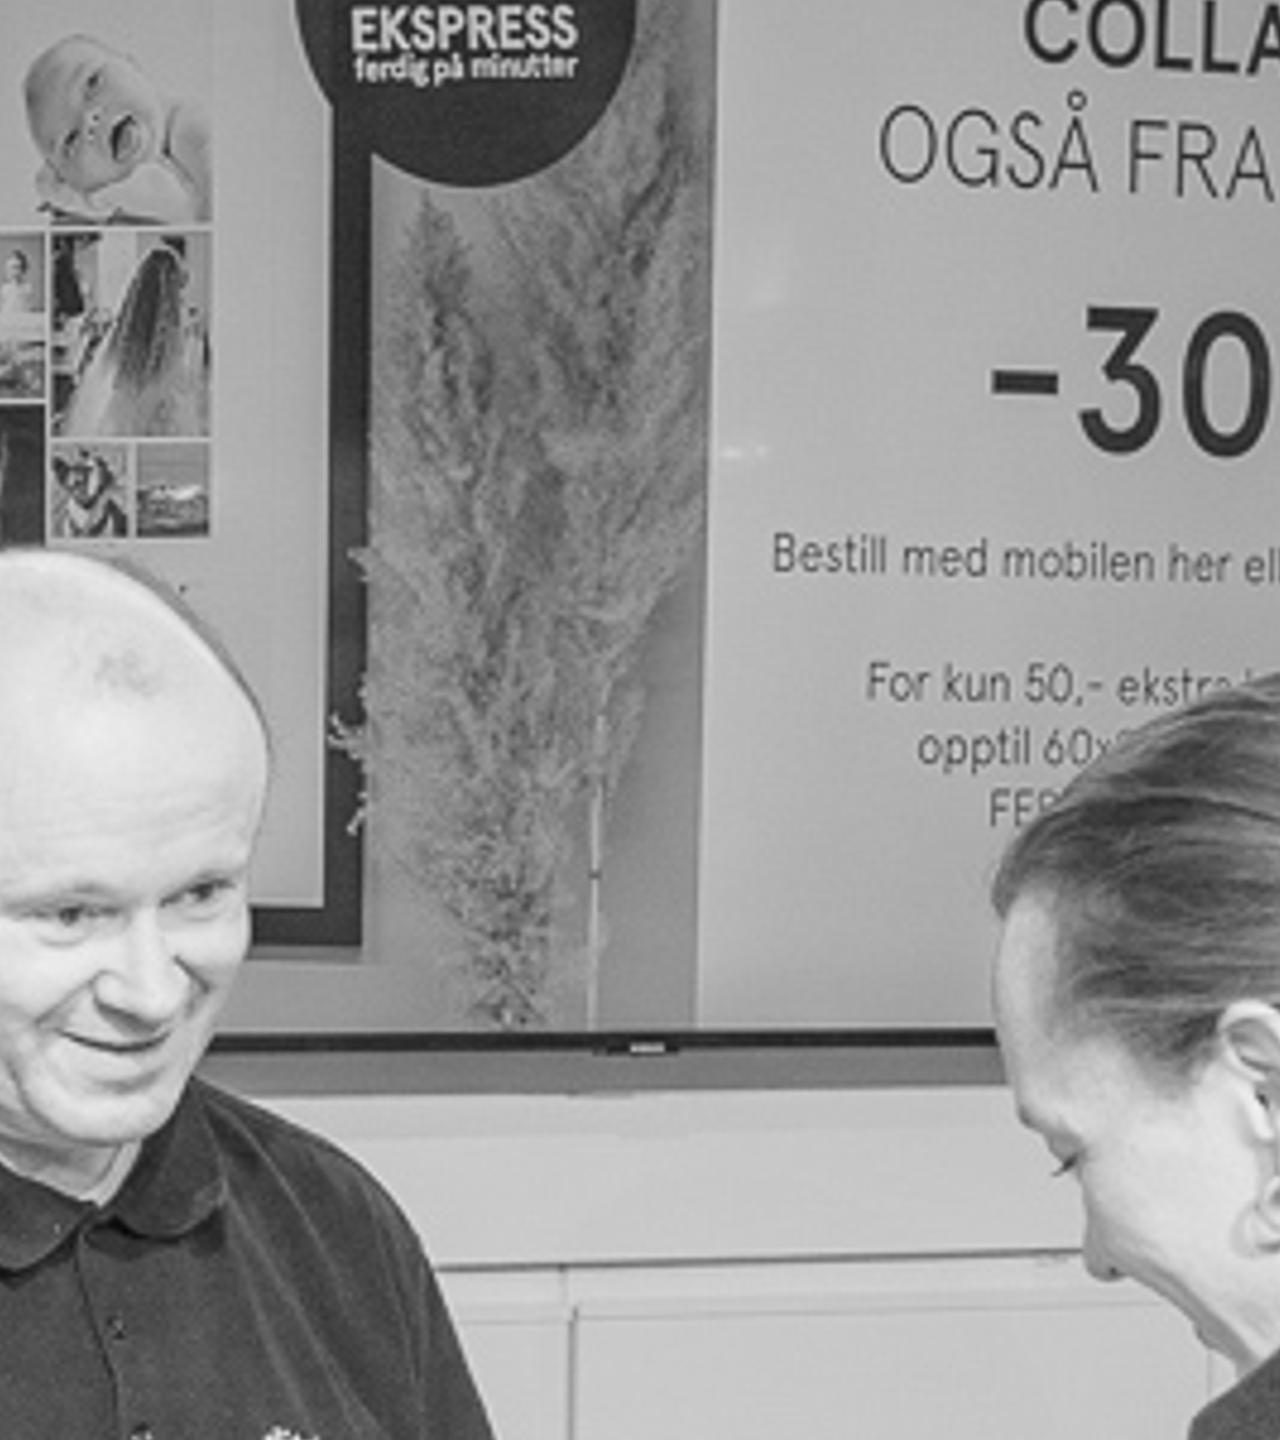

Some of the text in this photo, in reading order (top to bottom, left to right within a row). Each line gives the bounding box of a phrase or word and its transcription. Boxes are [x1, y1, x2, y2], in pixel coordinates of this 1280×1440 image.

[351, 3, 579, 51] EKSPRESS
[353, 49, 580, 88] ferdig på minutter
[879, 88, 1100, 193] OGSÅ
[1128, 119, 1275, 203] FRA
[773, 531, 887, 575] Bestill
[902, 537, 988, 578] med
[1002, 540, 1156, 583] mobilen
[1168, 543, 1232, 584] her
[866, 660, 932, 703] For
[942, 662, 1012, 703] kun
[917, 725, 1031, 777] opptil
